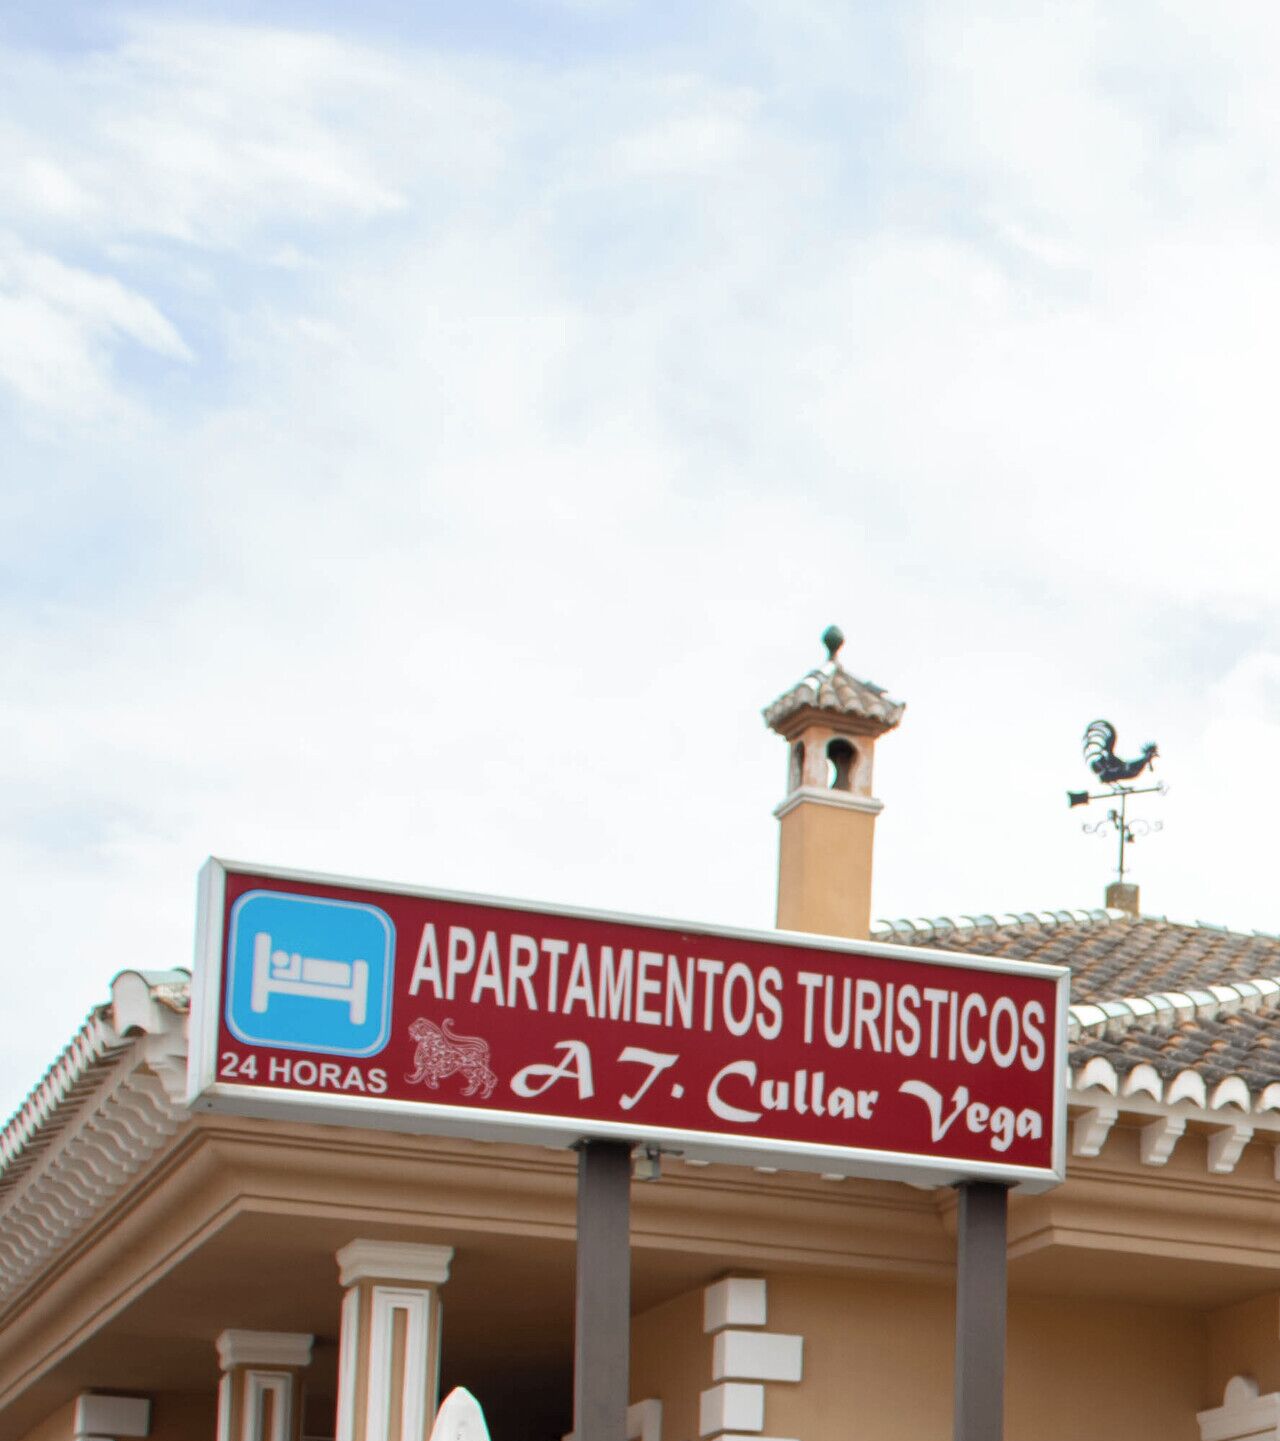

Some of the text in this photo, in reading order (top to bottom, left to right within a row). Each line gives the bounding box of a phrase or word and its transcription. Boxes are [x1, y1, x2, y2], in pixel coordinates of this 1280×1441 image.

[409, 922, 1047, 1072] APARTAMENTOS TURISTICOS
[220, 1052, 389, 1095] 24 HORAS
[707, 1060, 879, 1123] Cullar
[898, 1079, 1043, 1152] Vega
